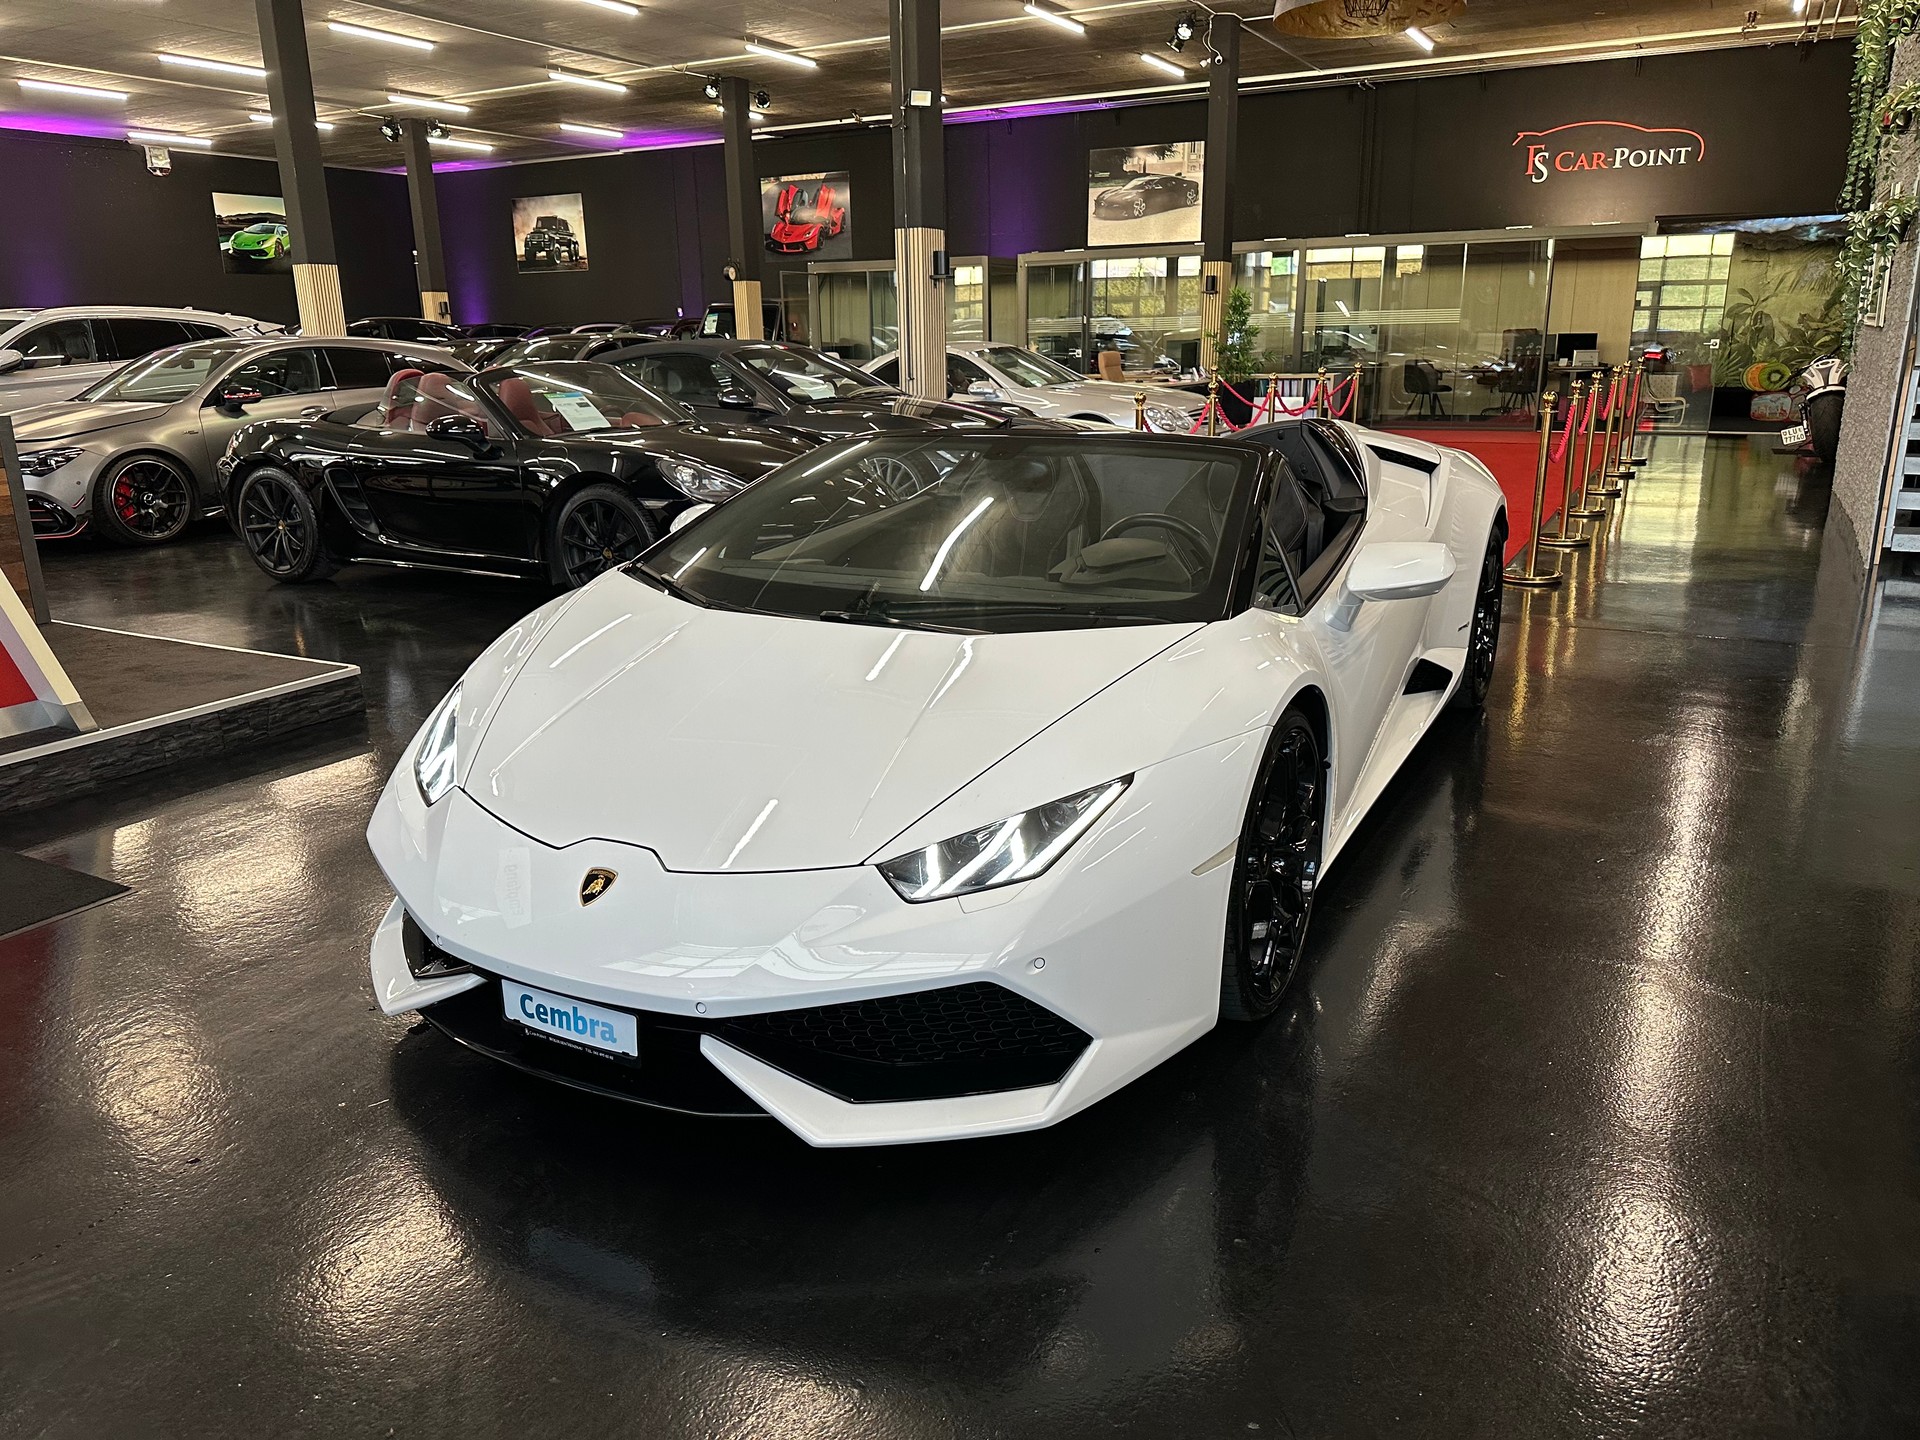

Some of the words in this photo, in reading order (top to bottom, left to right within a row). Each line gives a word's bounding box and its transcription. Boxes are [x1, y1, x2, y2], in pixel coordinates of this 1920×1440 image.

[1525, 144, 1549, 183] FS
[1554, 146, 1692, 172] CAR-POINT
[520, 993, 617, 1044] Cembra
